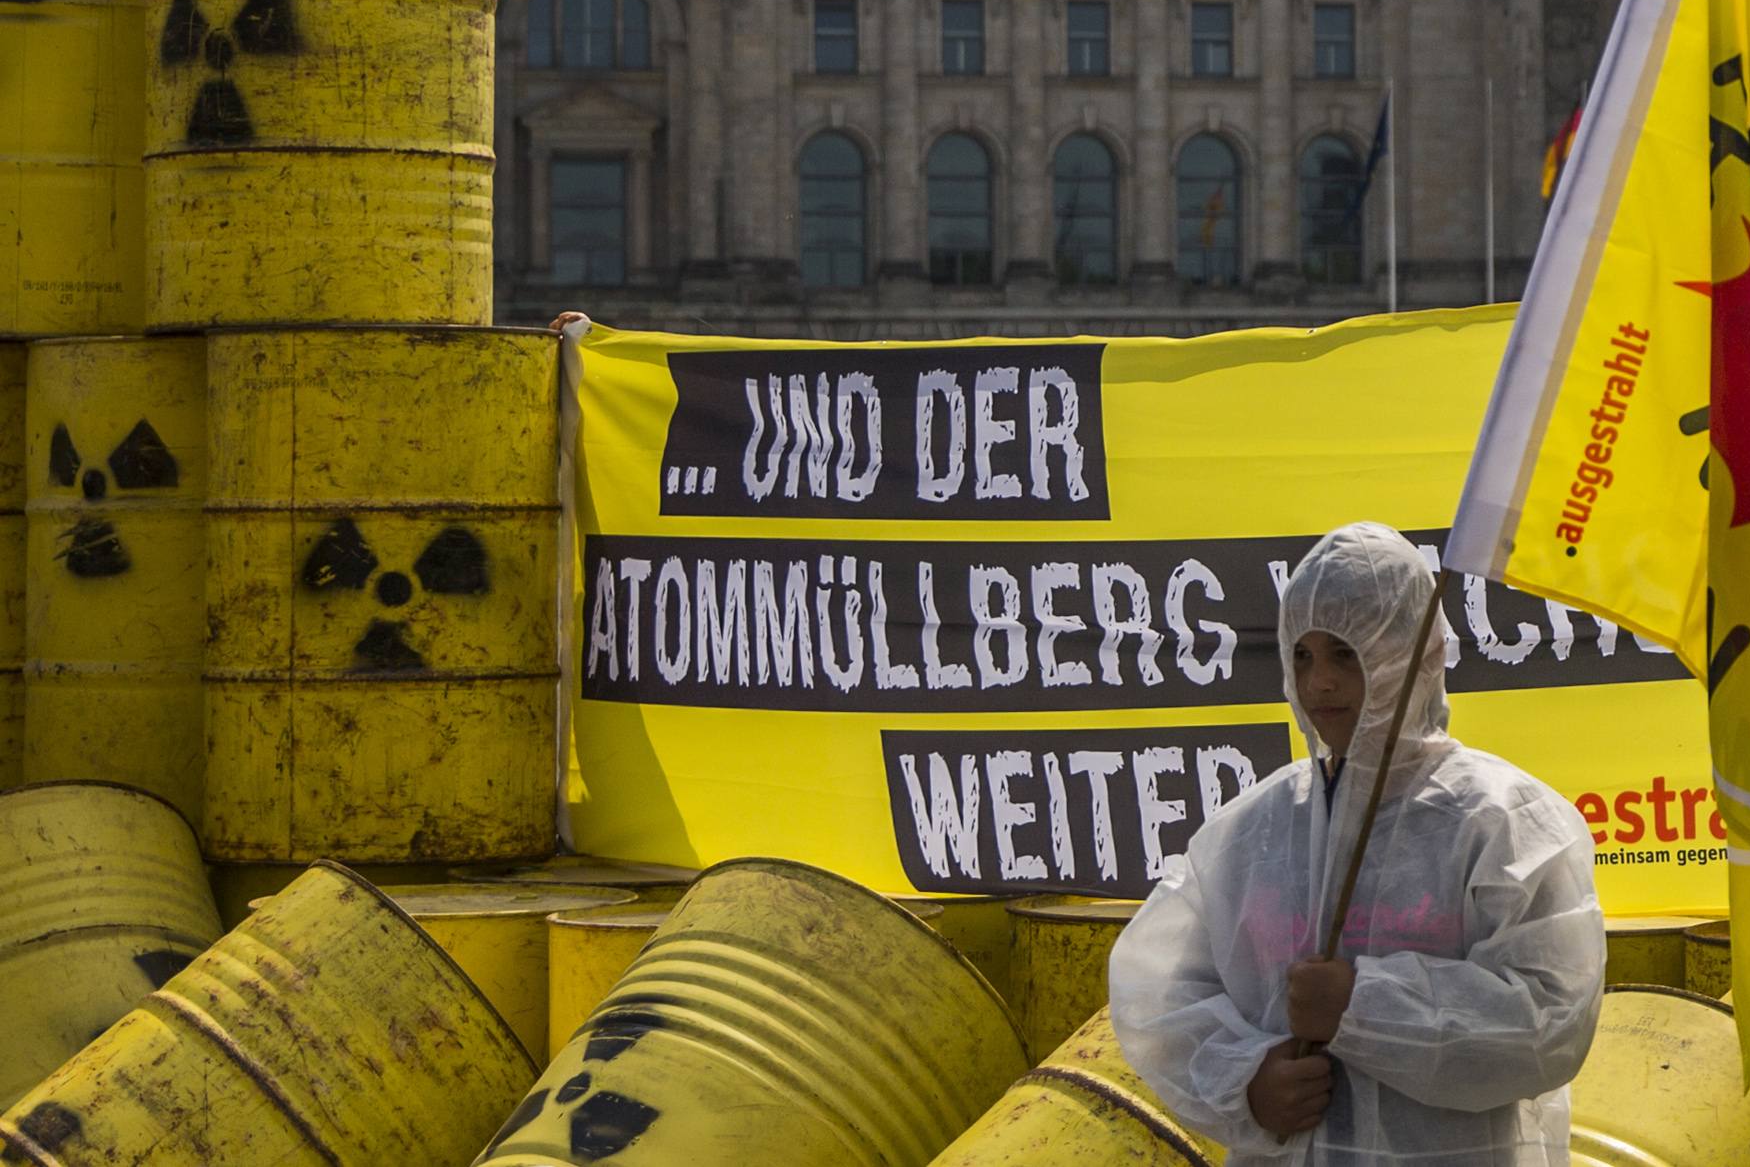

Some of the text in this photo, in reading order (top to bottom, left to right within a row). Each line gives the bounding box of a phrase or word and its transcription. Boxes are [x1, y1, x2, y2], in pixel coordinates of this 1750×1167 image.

[742, 369, 884, 502] UND
[915, 365, 1091, 503] DER
[587, 554, 1239, 692] ATOMMÜLLBERG
[1593, 846, 1729, 866] meinsam gegen
